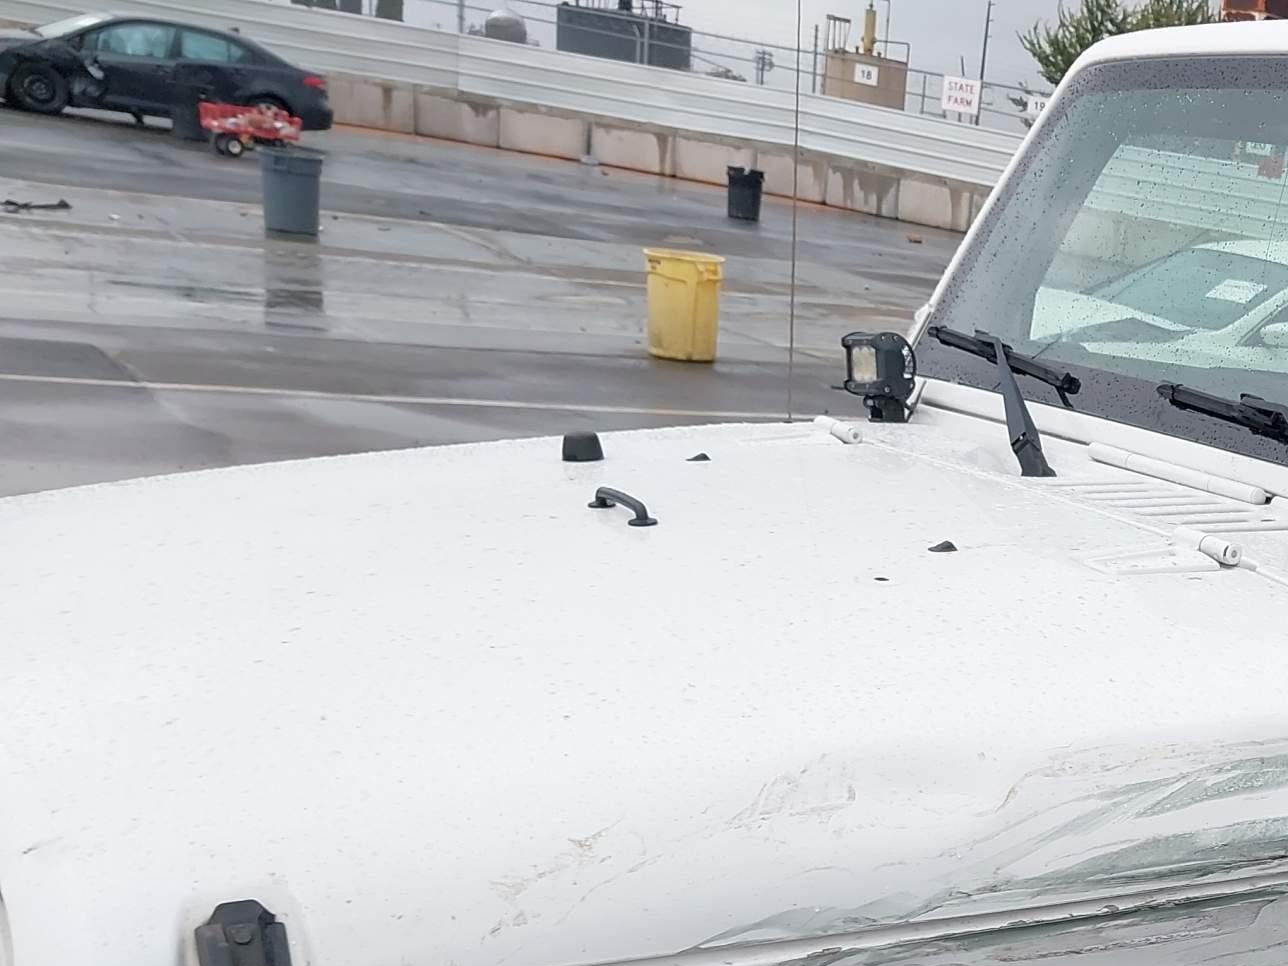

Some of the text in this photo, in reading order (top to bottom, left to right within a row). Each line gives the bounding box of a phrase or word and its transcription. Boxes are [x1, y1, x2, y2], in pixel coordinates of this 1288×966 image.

[948, 81, 975, 94] STATE
[947, 96, 973, 108] FARM
[1034, 101, 1046, 113] 19
